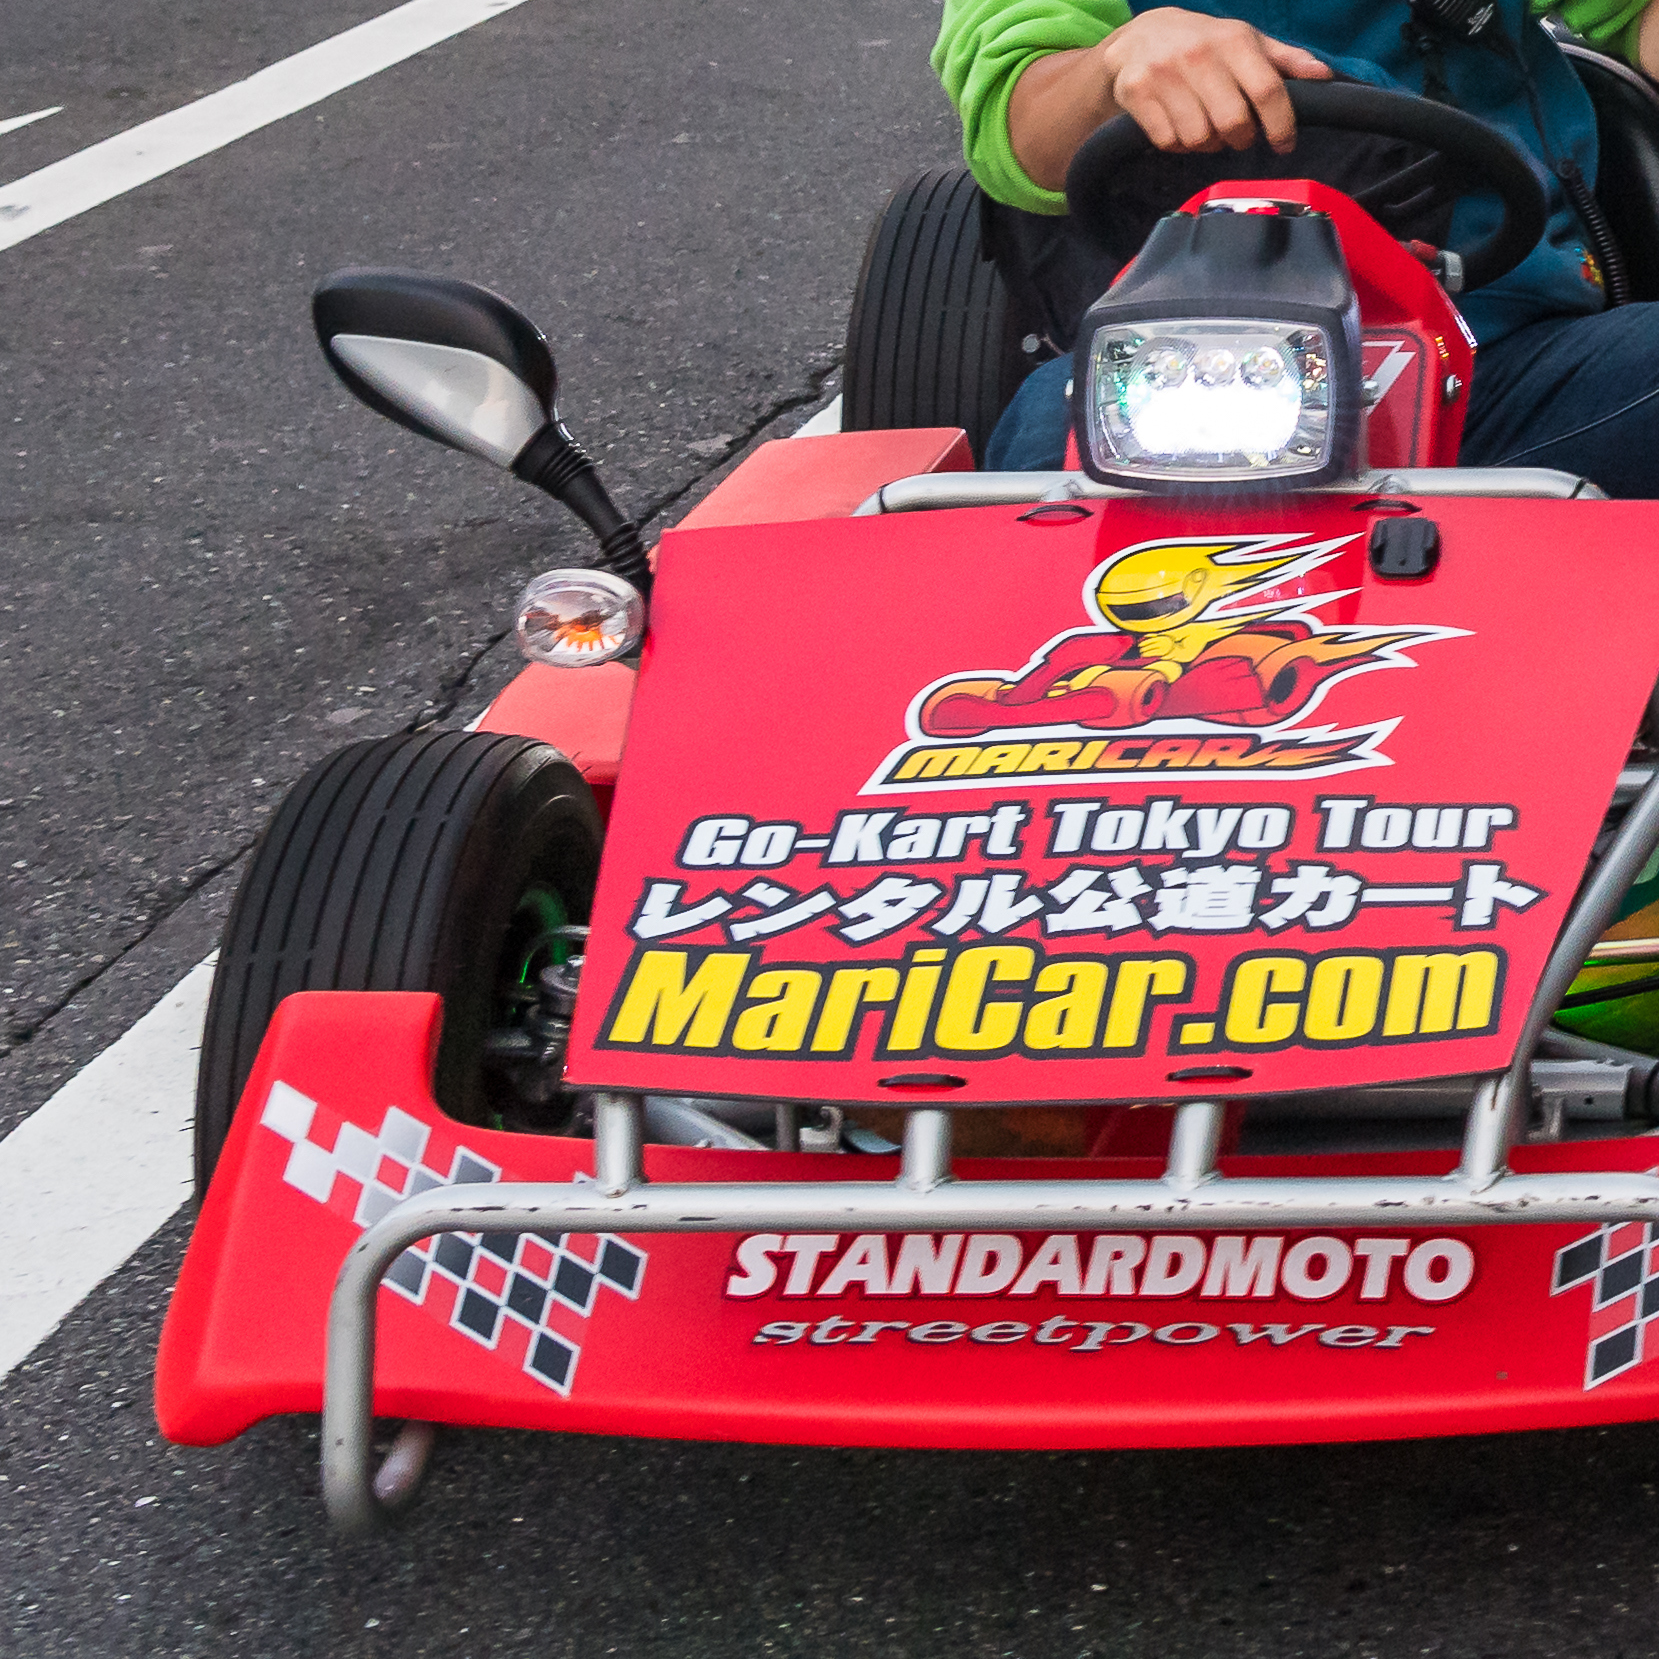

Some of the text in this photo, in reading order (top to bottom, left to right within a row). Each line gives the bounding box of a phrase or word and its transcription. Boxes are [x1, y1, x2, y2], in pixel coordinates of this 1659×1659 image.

[893, 738, 1285, 780] MARICAR
[681, 797, 1515, 868] Go-Kart Tokyo Tour
[631, 864, 1541, 942] レンタル公道カート
[608, 945, 1500, 1051] MariCar.com
[726, 1233, 1474, 1302] STANDARDMOTO
[753, 1314, 1435, 1351] streetpower
